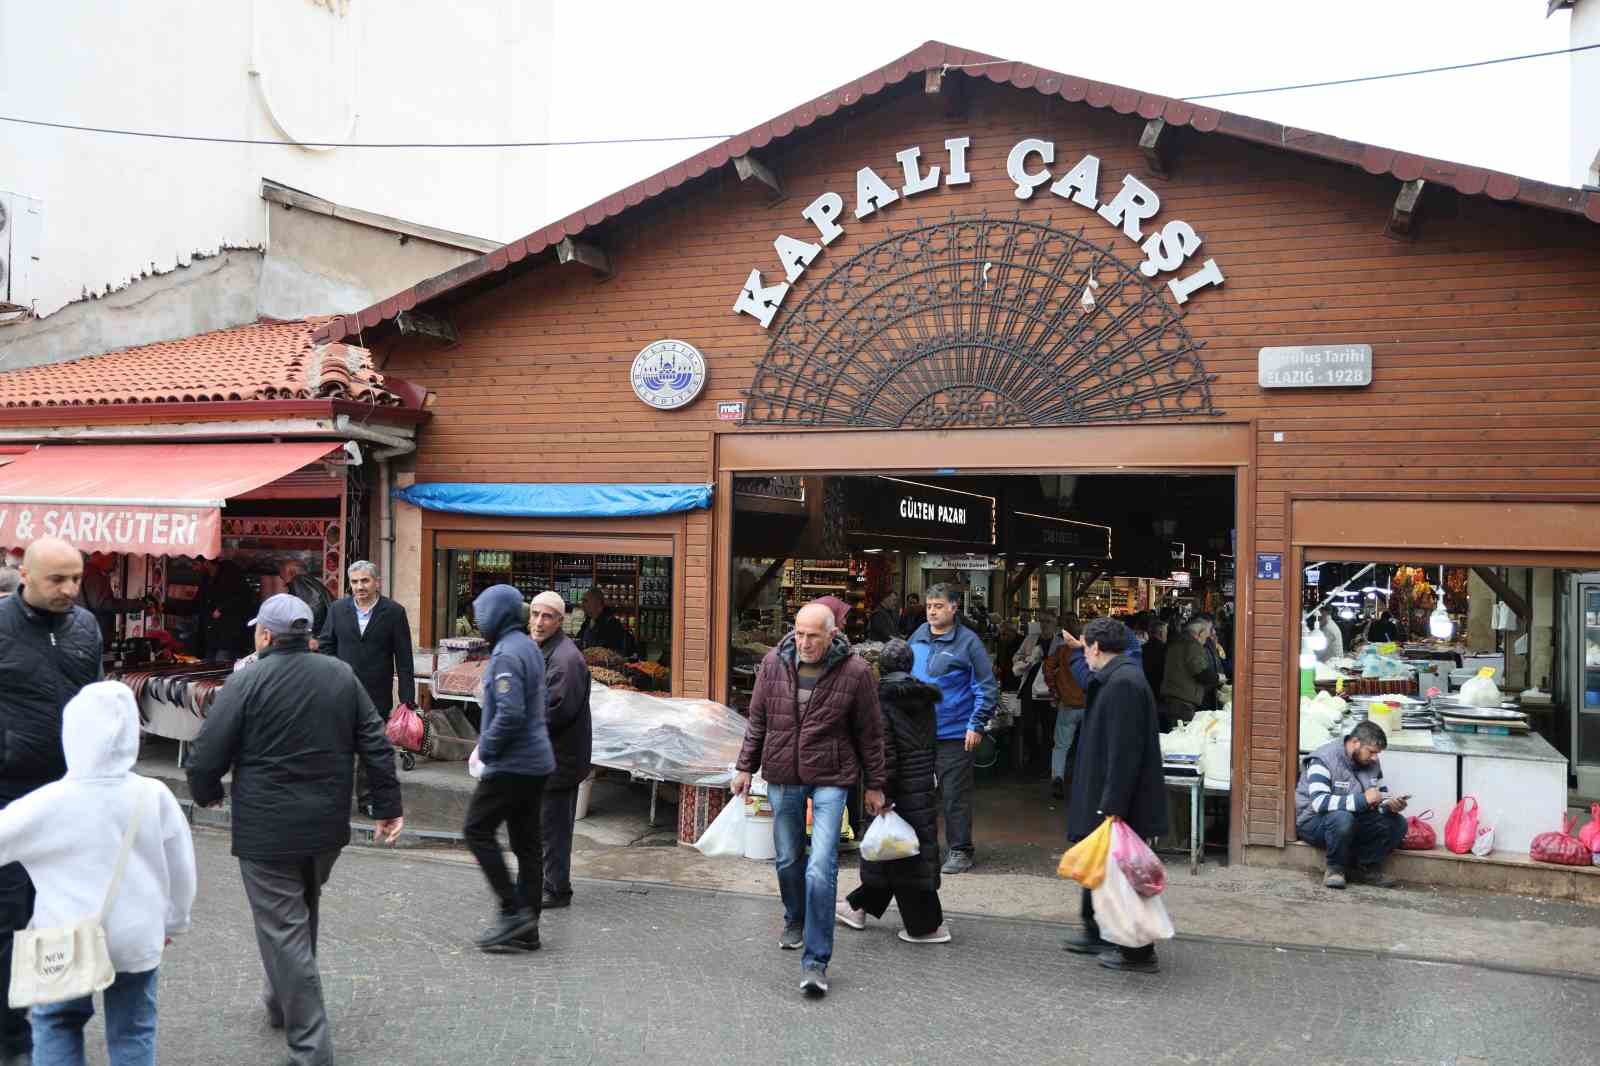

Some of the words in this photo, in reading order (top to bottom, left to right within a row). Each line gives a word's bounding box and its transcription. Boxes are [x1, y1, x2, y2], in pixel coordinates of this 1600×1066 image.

[732, 136, 971, 329] KAPALI
[1006, 138, 1225, 305] ÇARŞI
[1324, 347, 1365, 363] Tarihi
[1327, 368, 1363, 383] 1928
[720, 403, 741, 413] met
[900, 496, 935, 521] GÜLTEN
[938, 505, 966, 525] PAZARI
[45, 951, 65, 963] NEW
